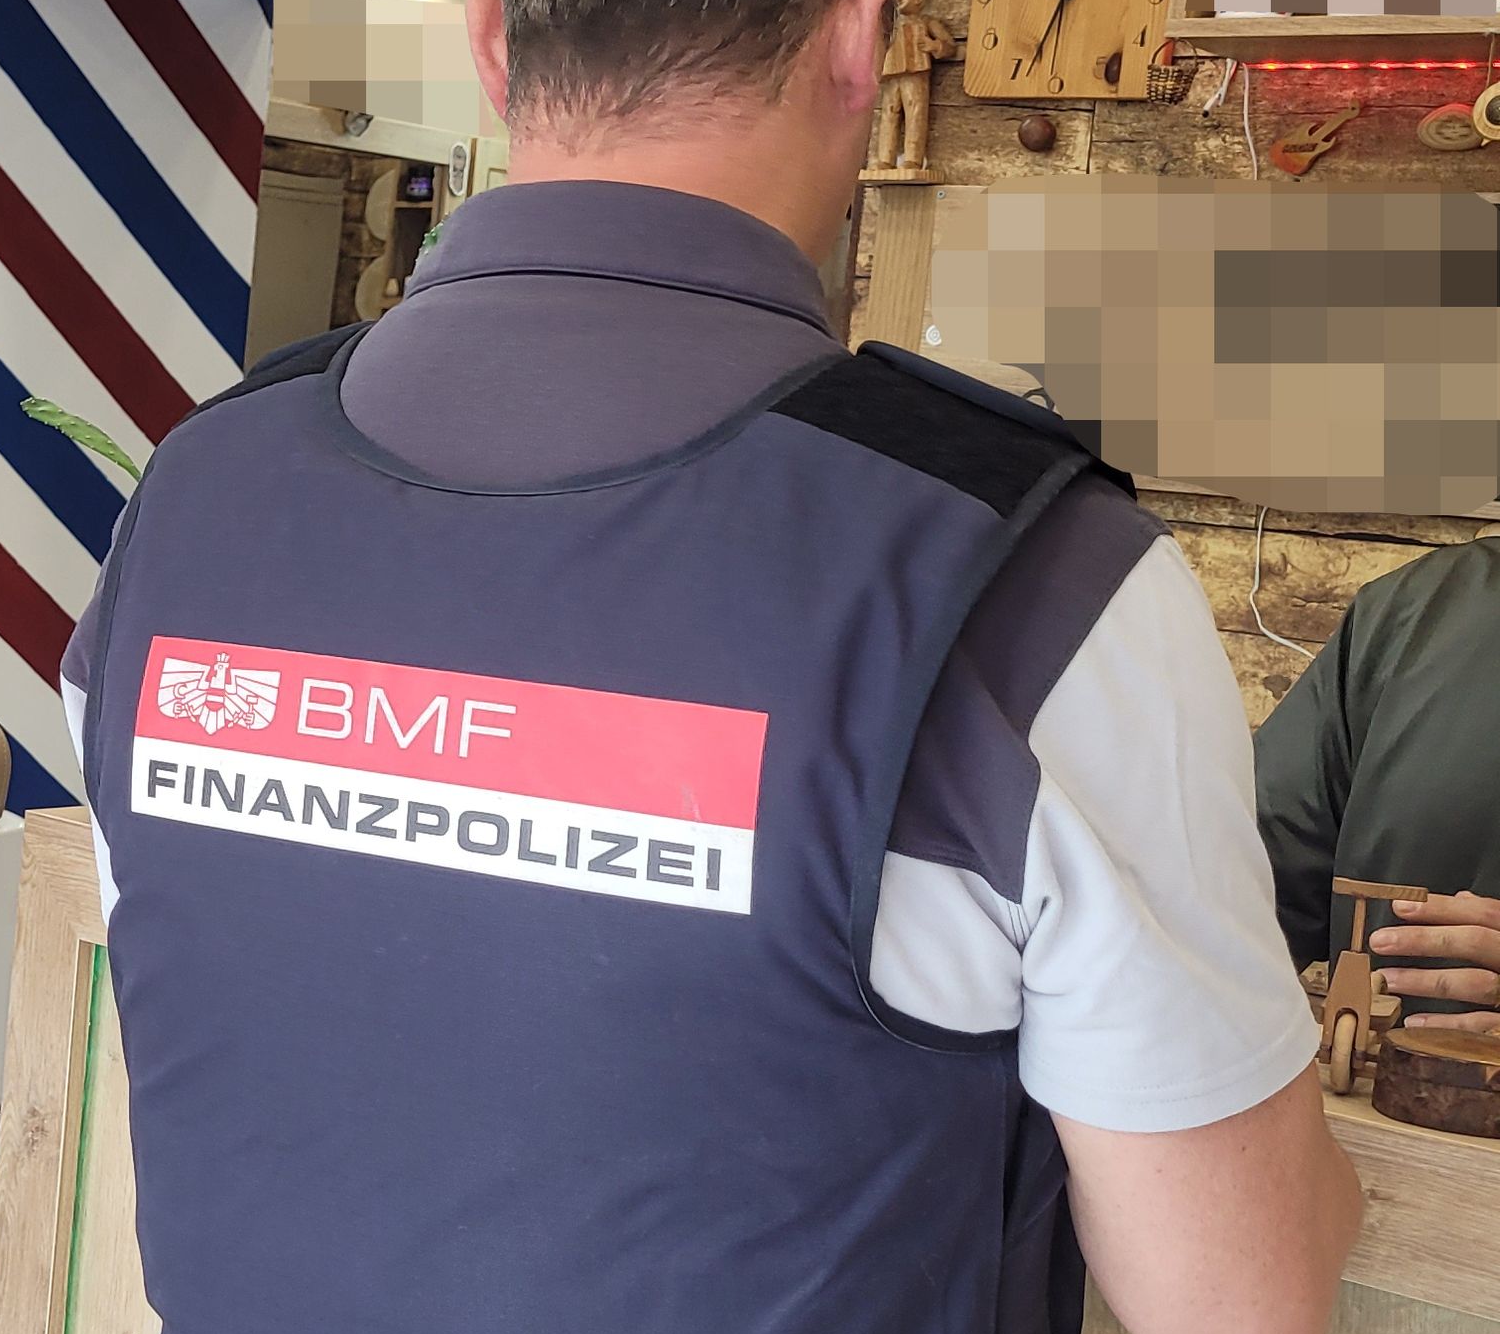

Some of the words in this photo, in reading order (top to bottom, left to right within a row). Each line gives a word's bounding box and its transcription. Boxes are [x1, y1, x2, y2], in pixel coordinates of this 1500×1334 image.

[1132, 25, 1147, 48] 4
[1010, 58, 1023, 80] 7
[295, 676, 518, 759] BMF
[147, 758, 722, 892] FINANZPOLIZEI
